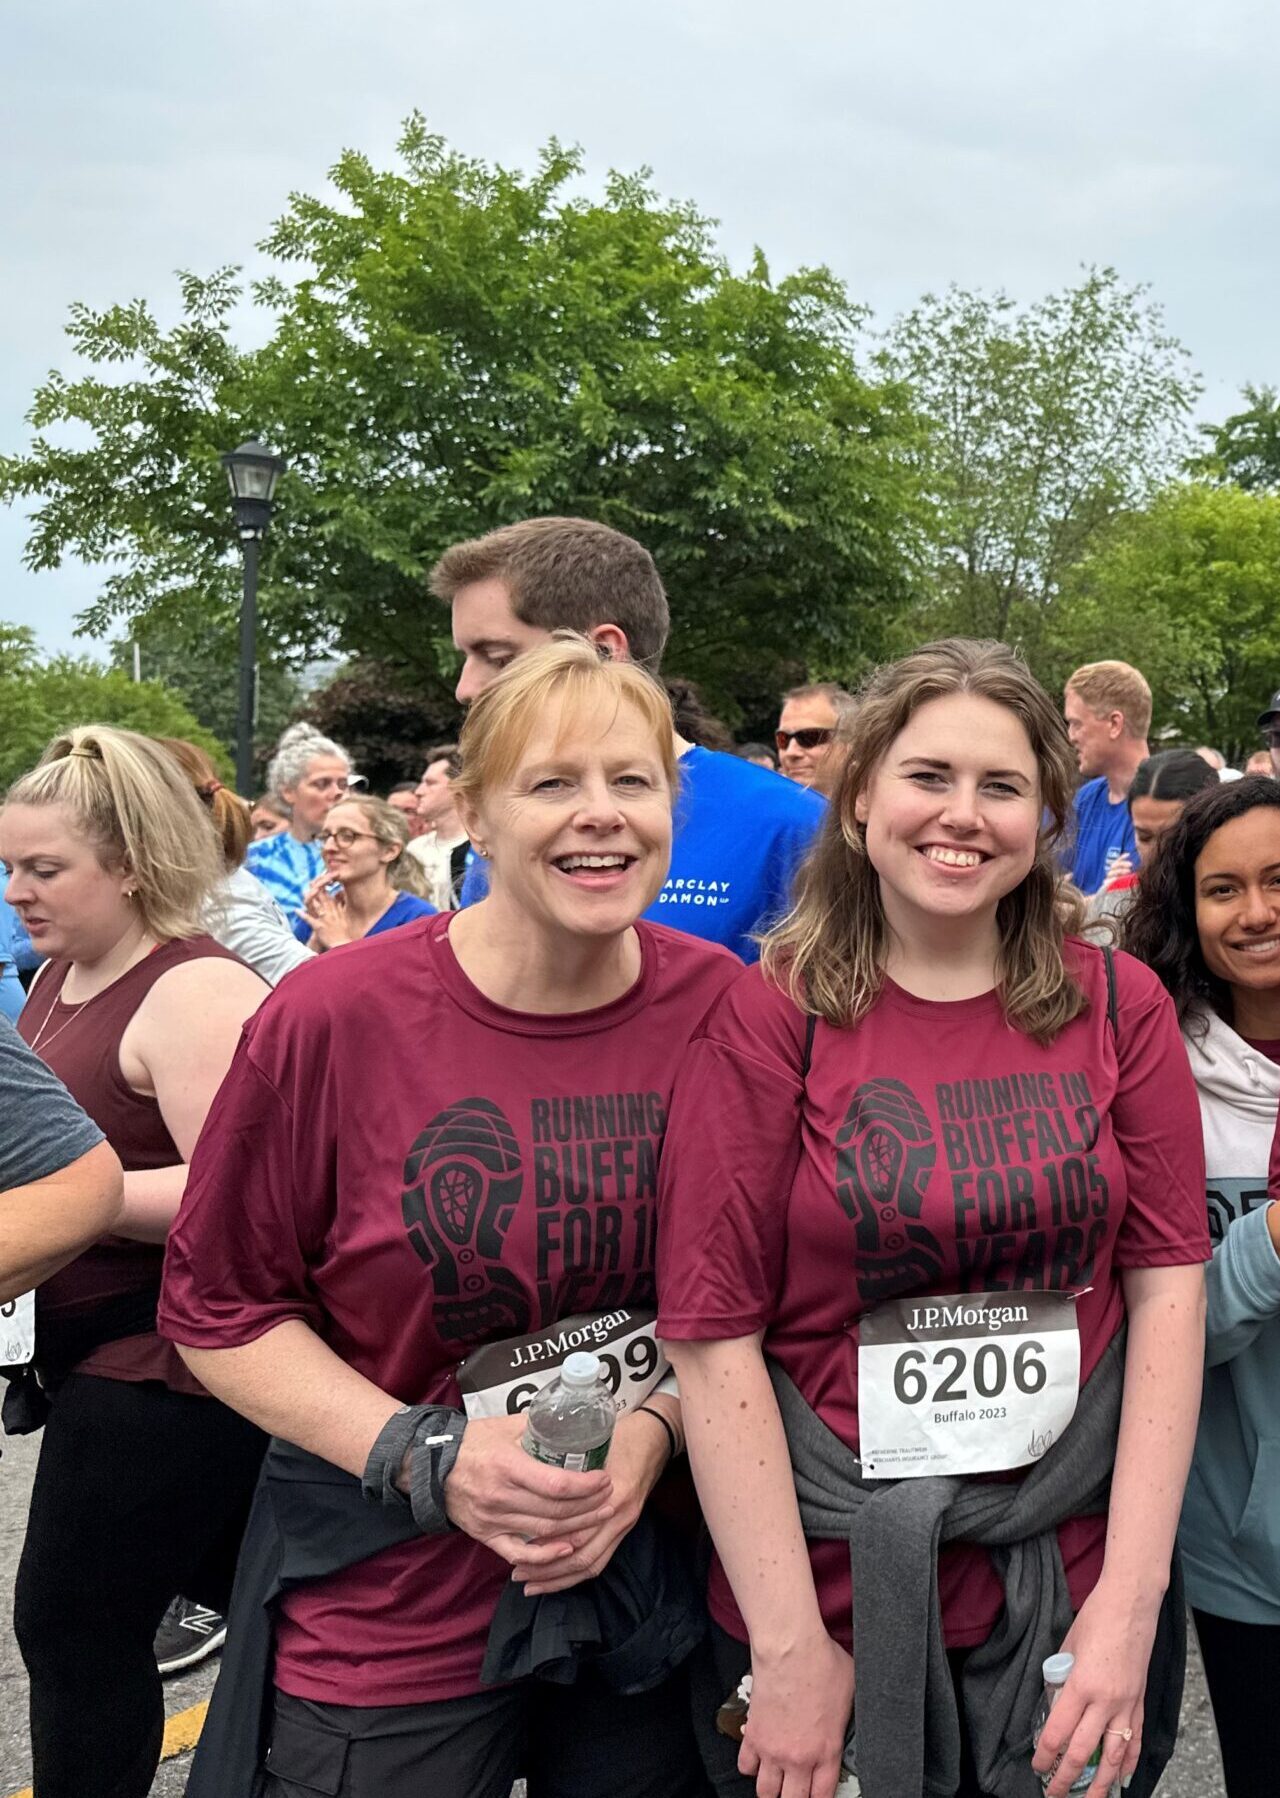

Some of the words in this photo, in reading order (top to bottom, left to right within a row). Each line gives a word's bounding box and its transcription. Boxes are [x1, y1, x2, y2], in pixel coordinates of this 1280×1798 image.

[659, 893, 717, 906] DAMON
[664, 879, 730, 892] ARCLAY
[531, 1092, 666, 1143] RUNNING
[935, 1072, 1059, 1121] RUNNING
[1059, 1072, 1093, 1106] IN
[941, 1104, 1100, 1171] BUFFALO
[534, 1139, 657, 1208] BUFFA
[951, 1166, 1037, 1239] FOR
[1042, 1154, 1109, 1227] 105
[537, 1206, 622, 1280] FOR
[510, 1309, 631, 1368] J.P.Morgan
[905, 1305, 1028, 1331] J.P.Morgan
[506, 1335, 658, 1415] 699
[893, 1340, 1048, 1405] 6206
[934, 1409, 976, 1424] Buffalo
[979, 1407, 1007, 1420] 2023
